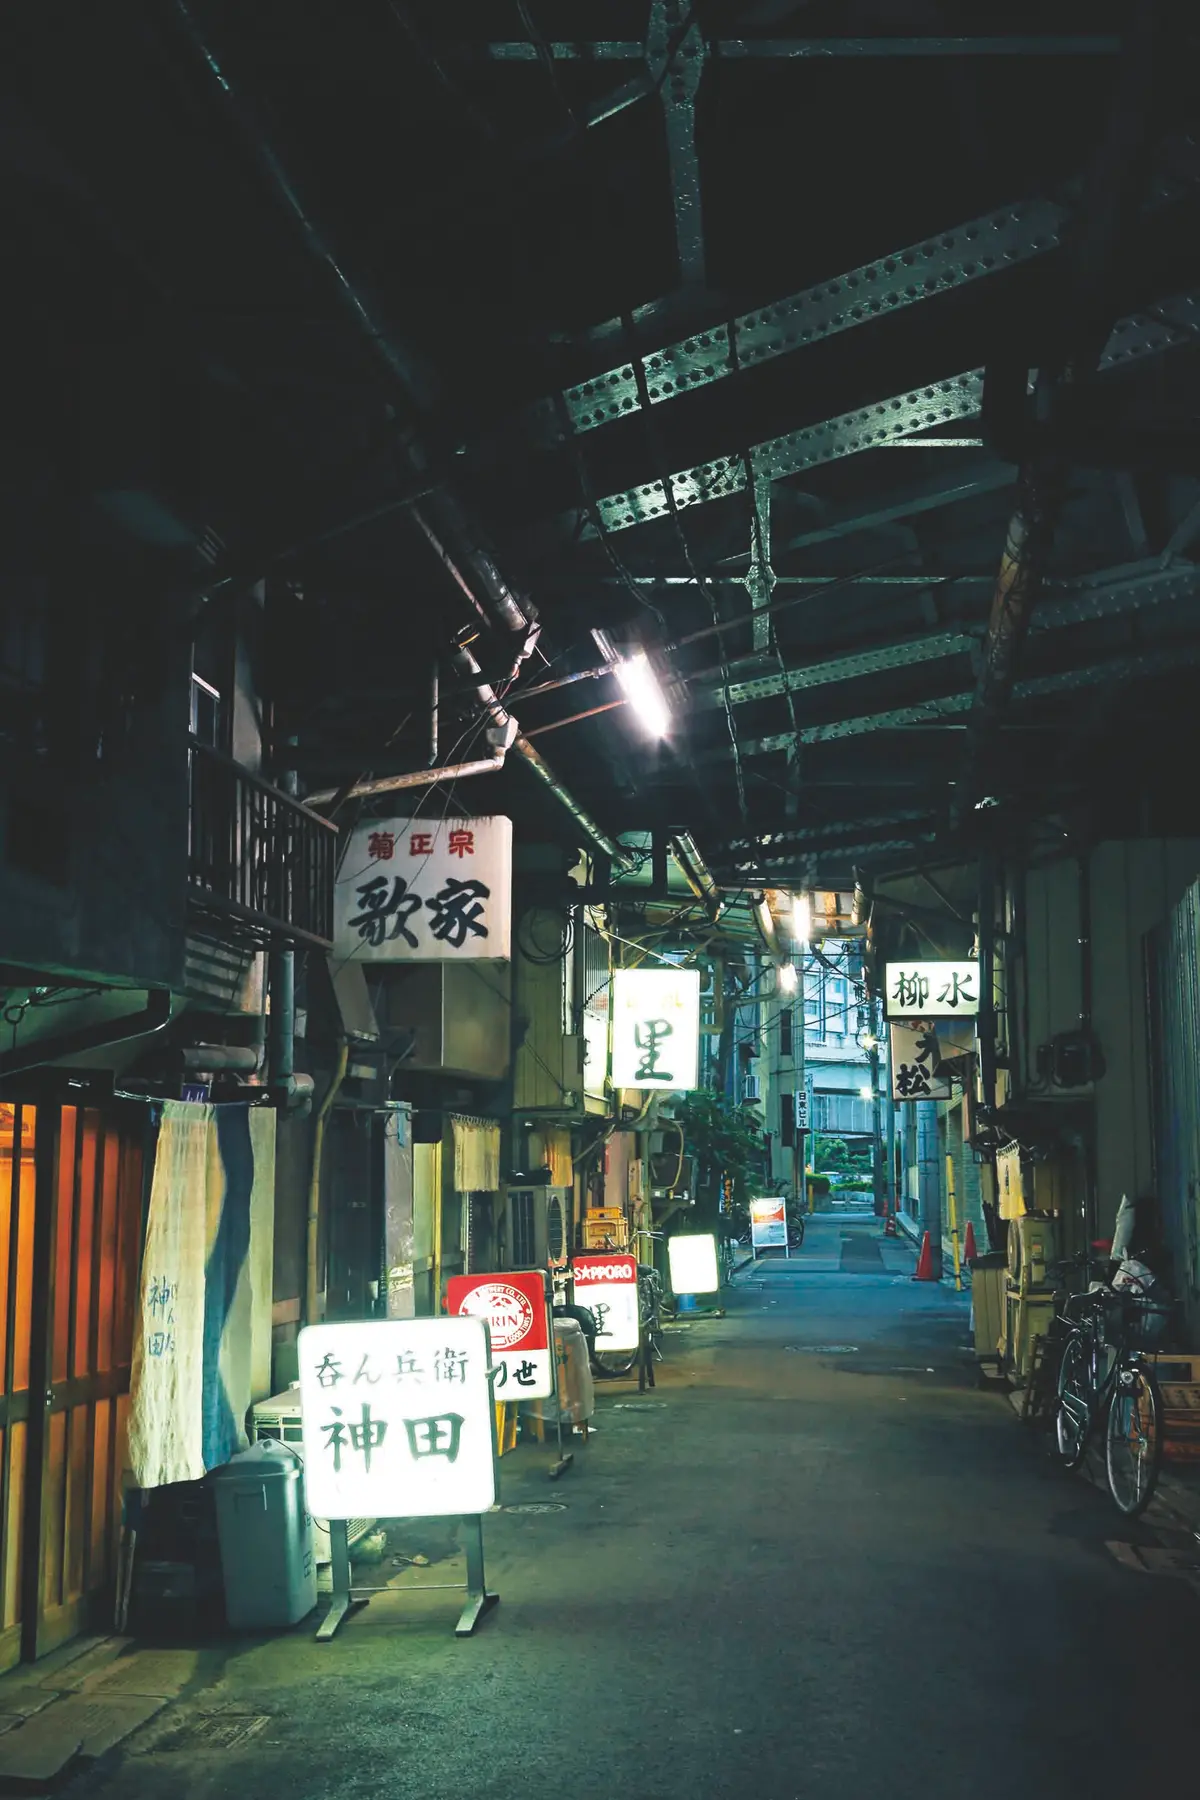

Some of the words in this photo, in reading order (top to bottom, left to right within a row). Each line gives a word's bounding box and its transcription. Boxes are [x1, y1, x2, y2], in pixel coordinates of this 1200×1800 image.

[368, 829, 475, 861] 菊正宗
[348, 875, 491, 949] 歌家
[892, 971, 978, 1009] 柳水
[634, 1019, 674, 1081] 里
[315, 1347, 468, 1388] 呑ん兵衛
[320, 1403, 465, 1473] 神田
